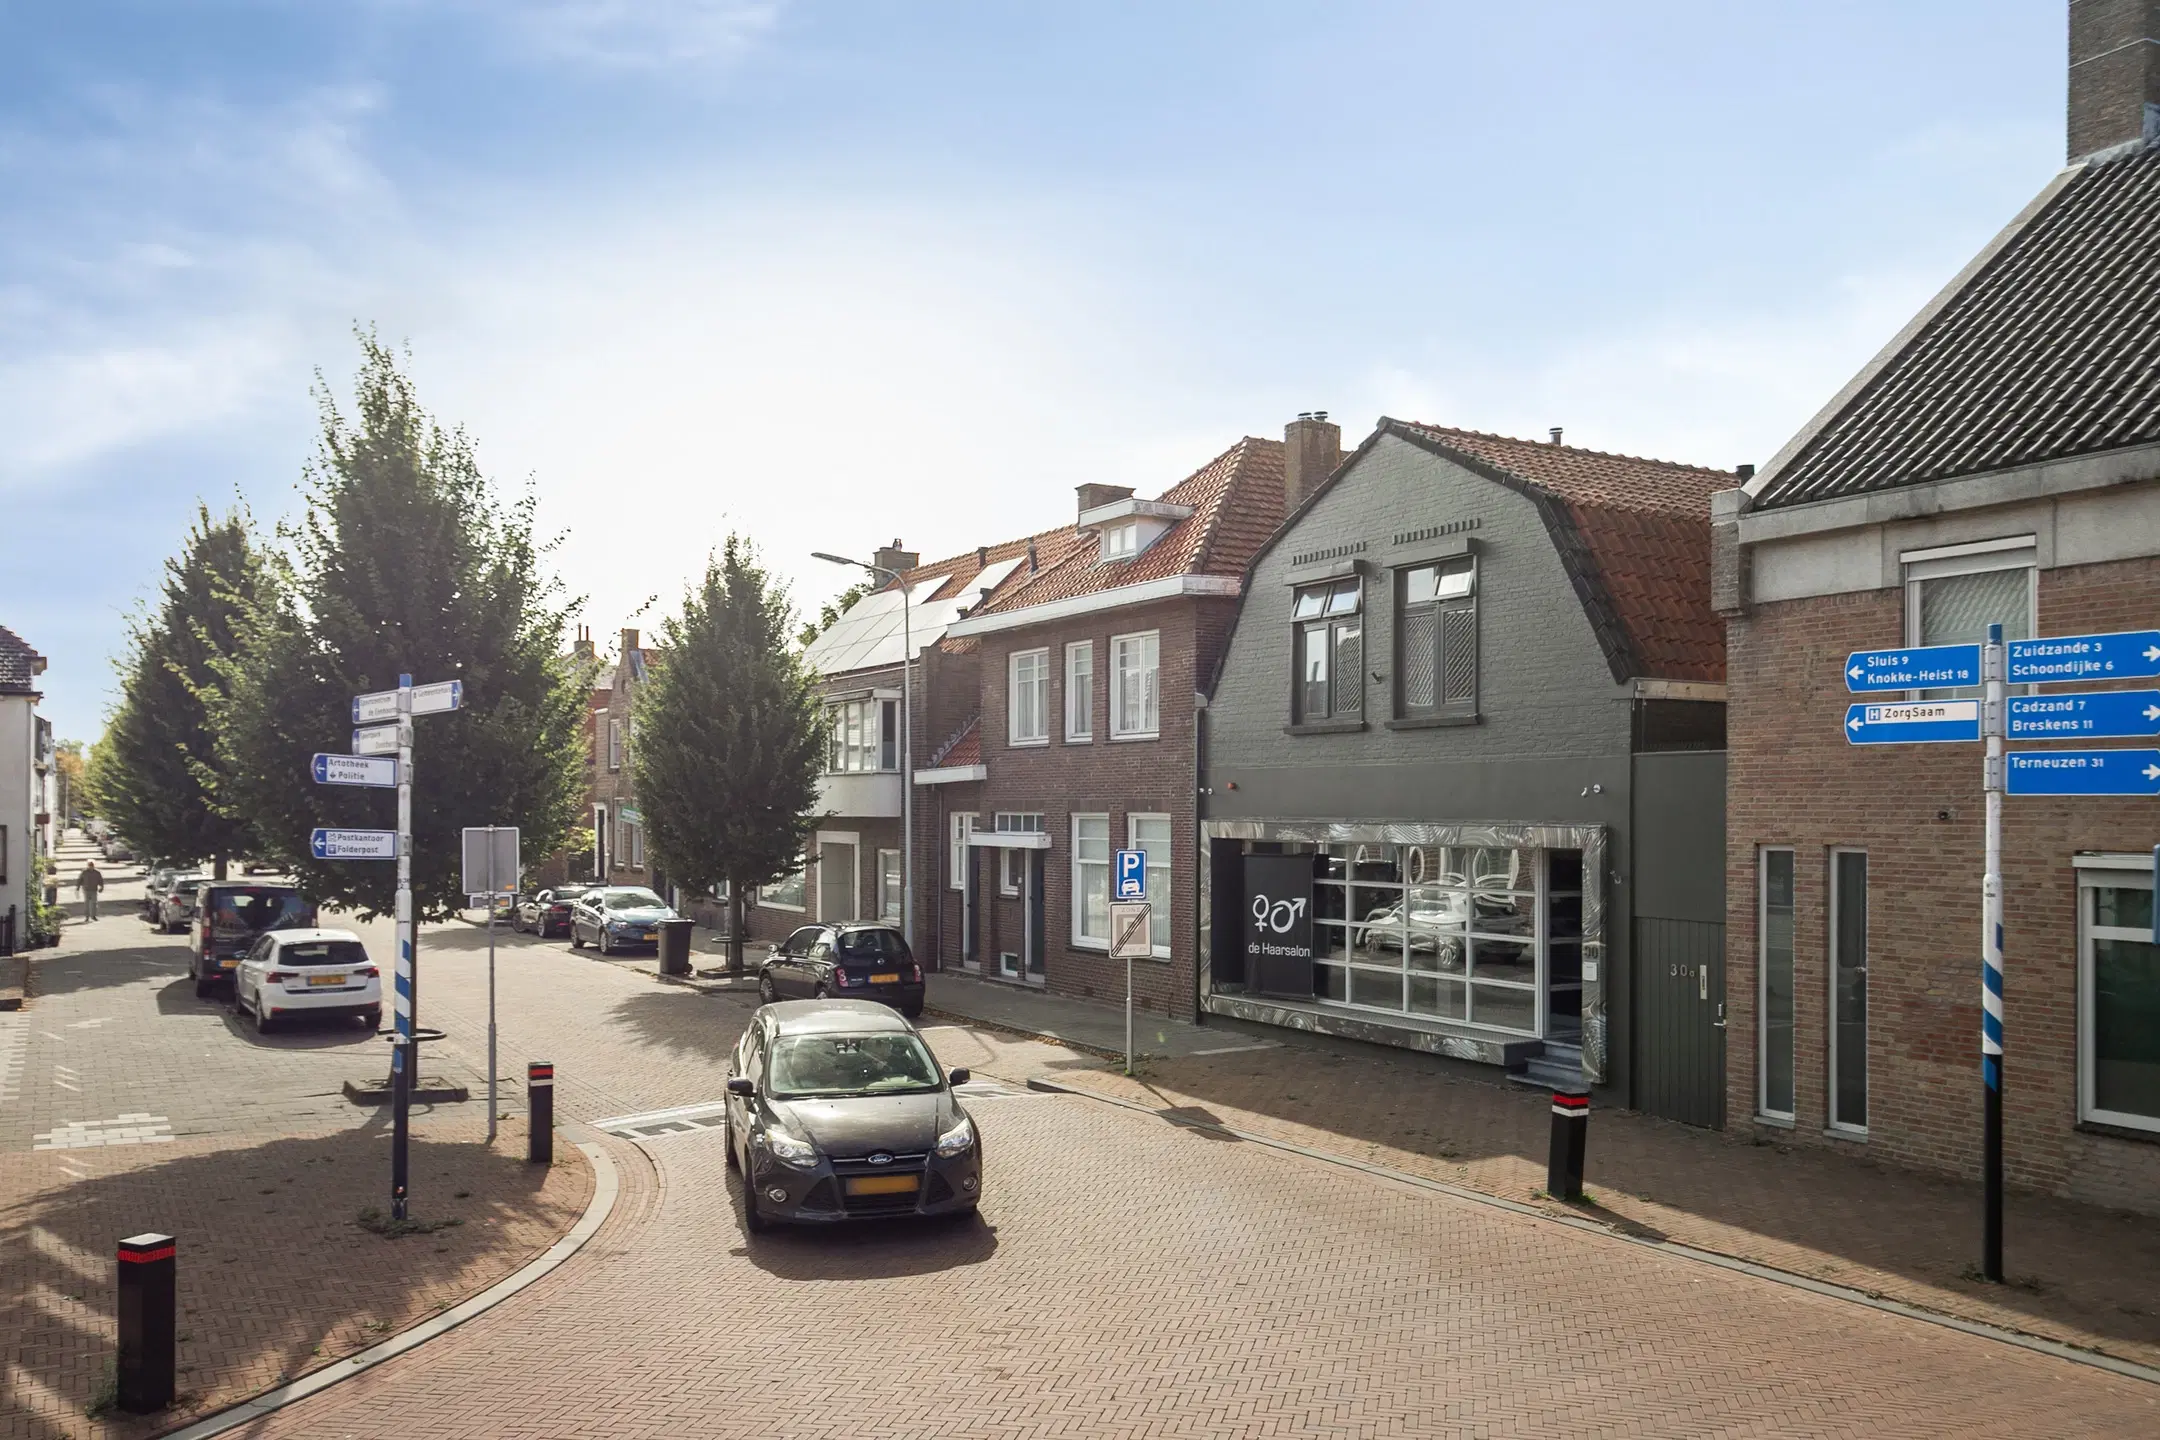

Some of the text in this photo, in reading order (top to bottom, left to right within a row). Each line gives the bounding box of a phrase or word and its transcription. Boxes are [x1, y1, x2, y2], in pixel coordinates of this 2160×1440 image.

[2013, 642, 2103, 658] Zuidzande 3
[1867, 656, 1909, 667] Sluis 9
[2012, 660, 2114, 676] Schoondijke 6
[1867, 669, 1969, 684] Knokke-Heist 18
[2012, 700, 2086, 713] Cadzand 7
[1884, 707, 1945, 720] ZorgSaam
[2012, 719, 2093, 731] Breskens 11
[328, 759, 369, 769] Artotheek
[2012, 757, 2104, 768] Terneuzen 31
[338, 771, 365, 780] Politie
[337, 833, 384, 842] Postkantoor
[337, 846, 379, 854] Folderpost
[1123, 853, 1140, 878] P
[1248, 942, 1310, 957] de Haarsalon
